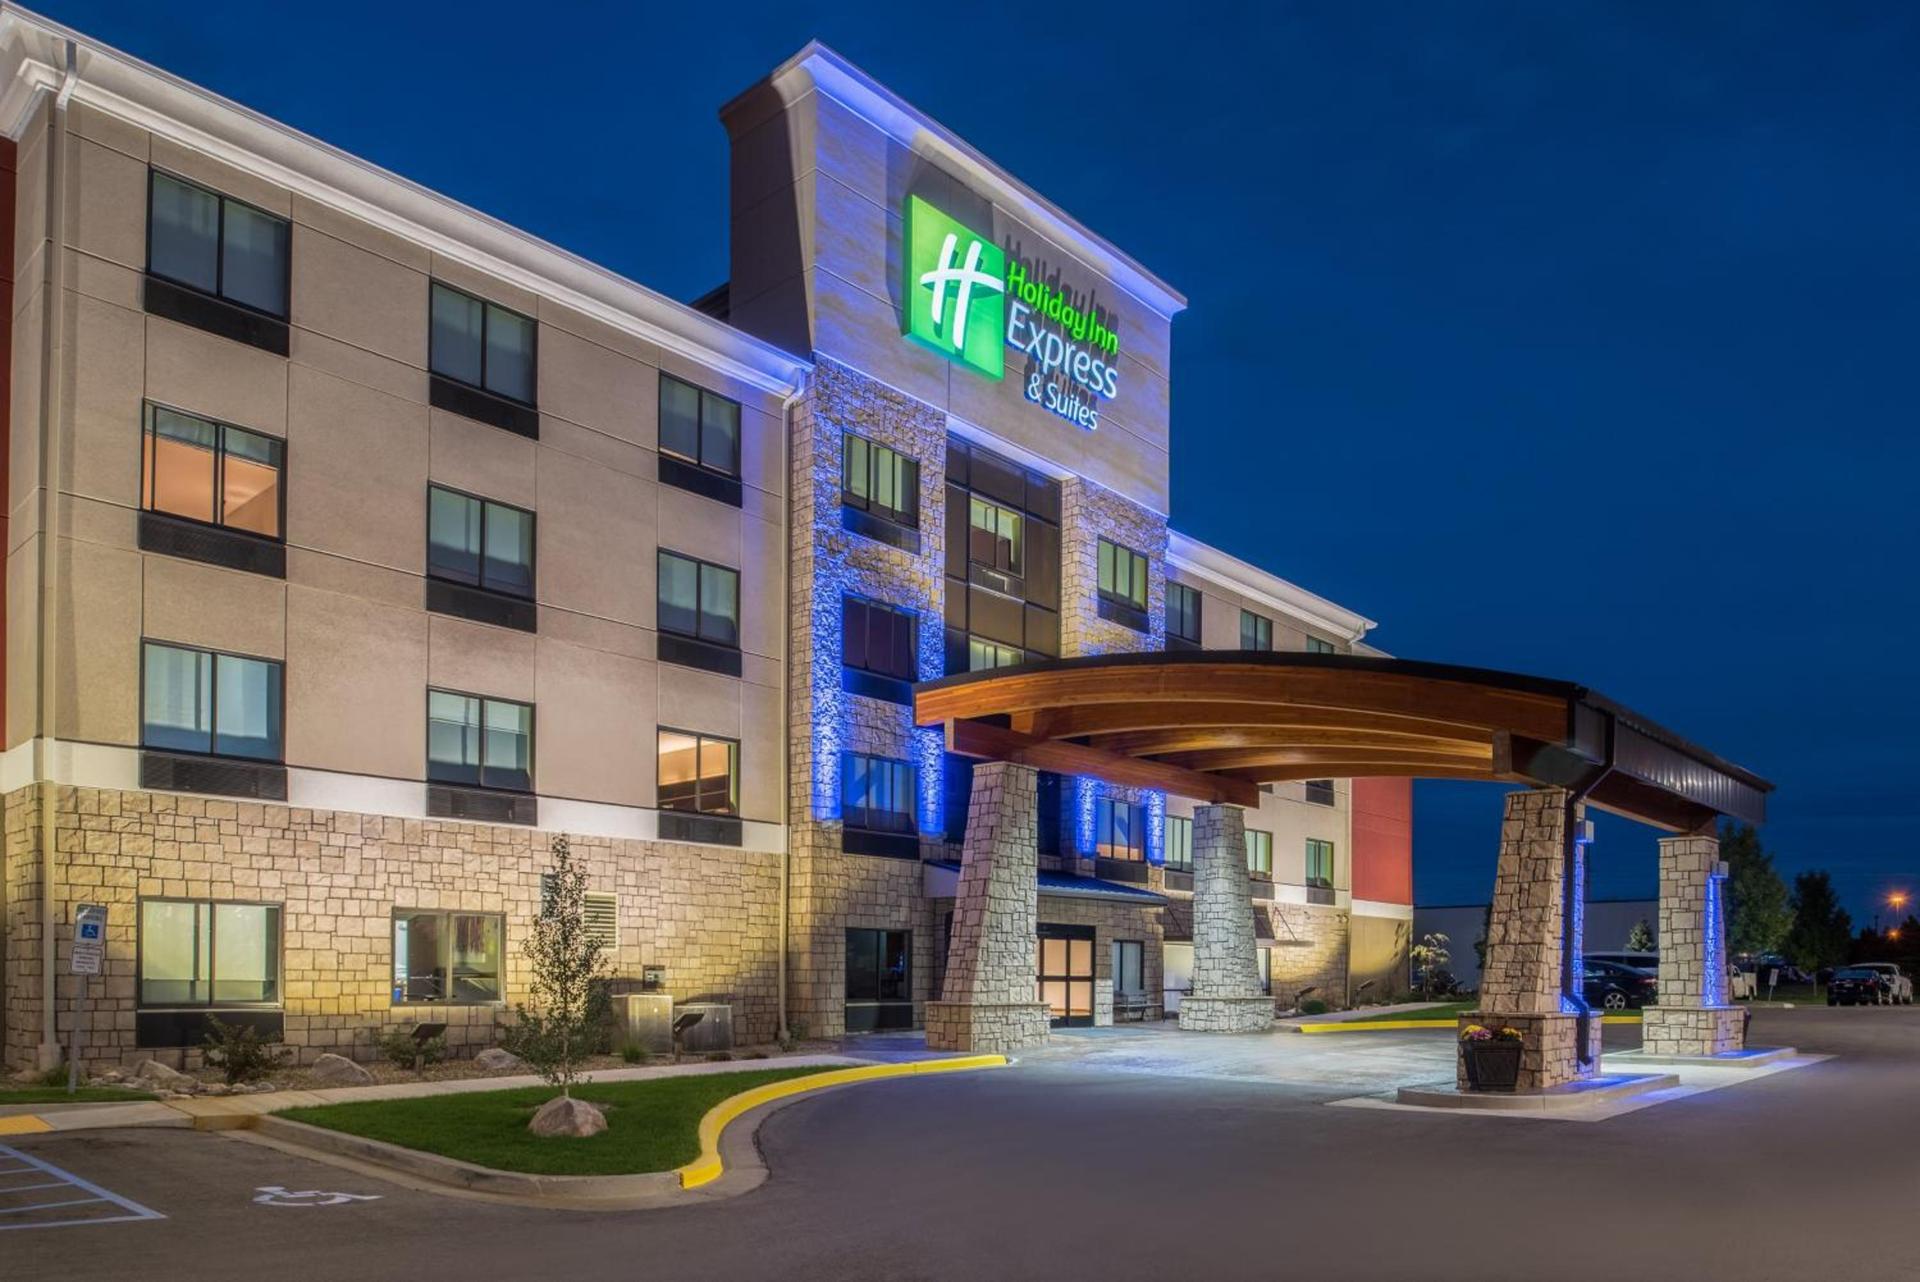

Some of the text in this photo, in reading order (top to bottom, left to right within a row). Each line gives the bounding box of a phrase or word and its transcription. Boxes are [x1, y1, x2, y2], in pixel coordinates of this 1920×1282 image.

[1008, 261, 1118, 355] Holiday Inn
[1008, 301, 1118, 399] Express
[1028, 373, 1098, 430] & Suites
